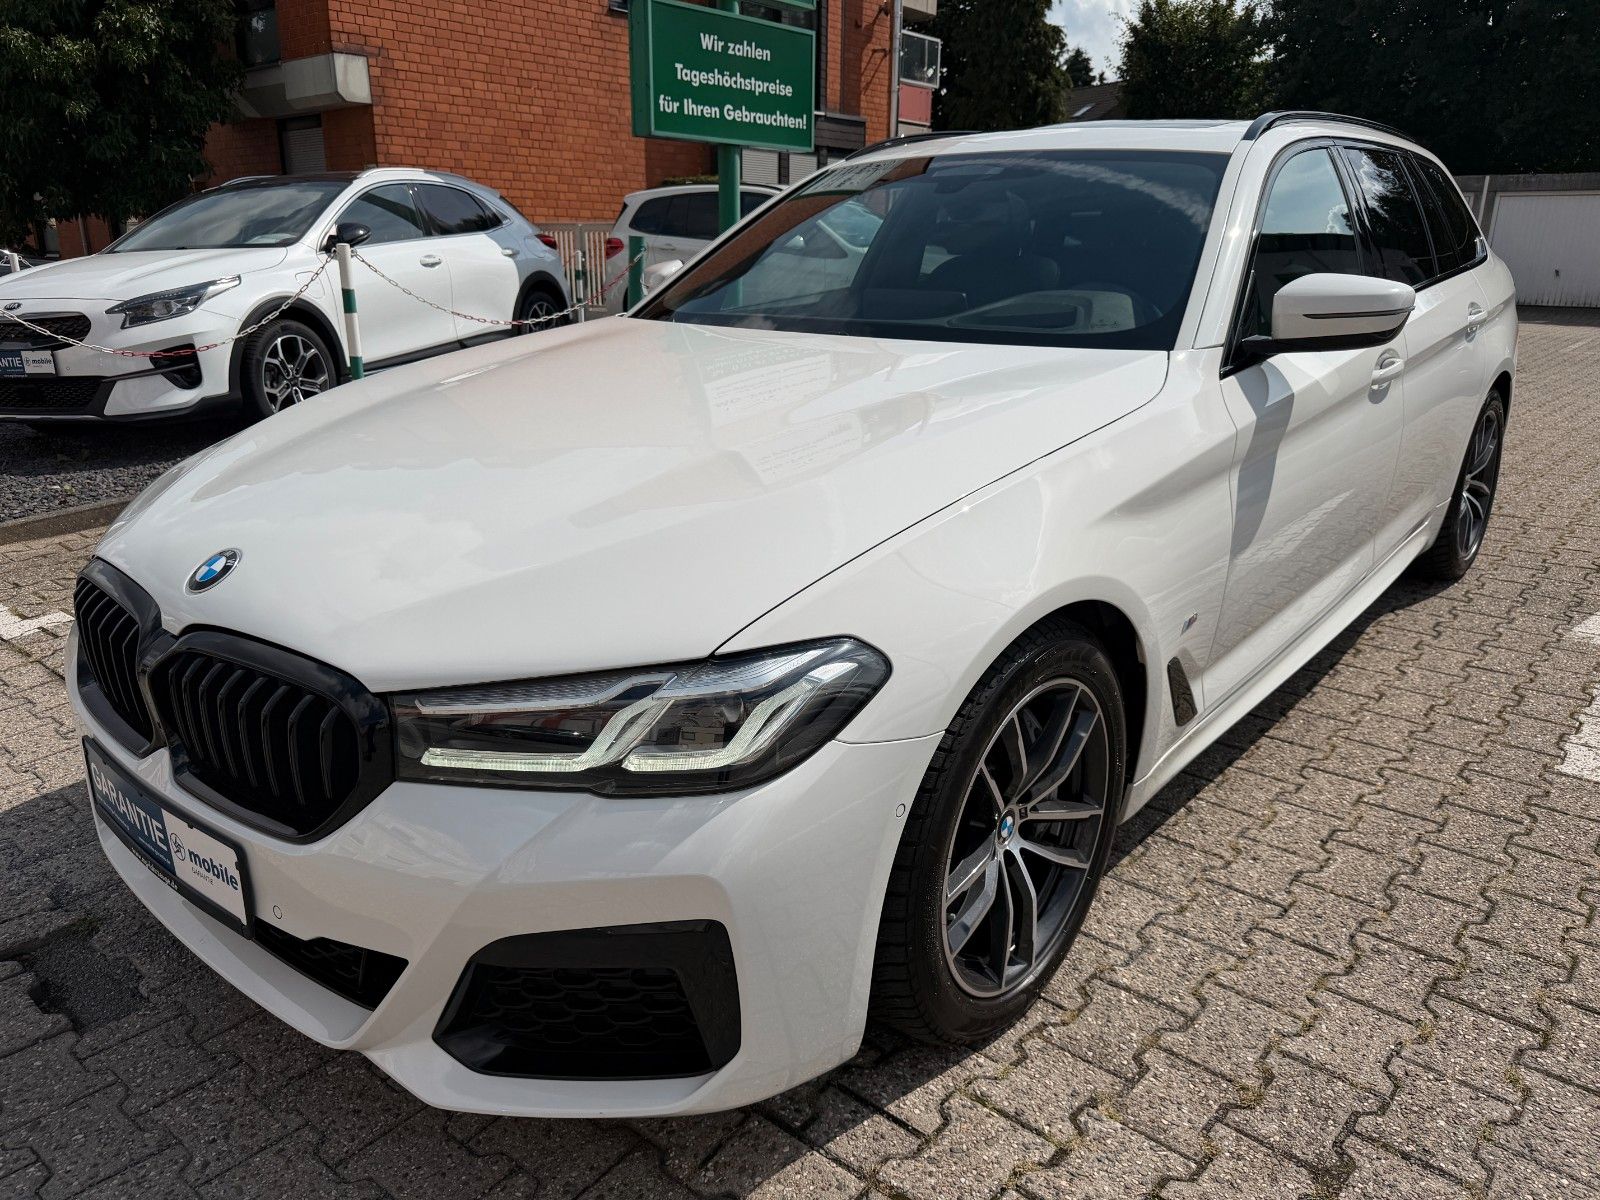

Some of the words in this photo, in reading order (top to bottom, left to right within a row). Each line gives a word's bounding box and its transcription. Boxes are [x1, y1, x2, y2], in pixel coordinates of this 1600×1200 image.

[700, 32, 725, 52] Wir
[728, 40, 771, 61] zahlen
[675, 63, 793, 96] Tageshöchstpreise
[659, 94, 679, 113] für
[683, 98, 720, 118] Ihren
[723, 104, 807, 129] Gebrauchten!
[91, 762, 168, 851] GARANTIE
[188, 849, 239, 890] mobile
